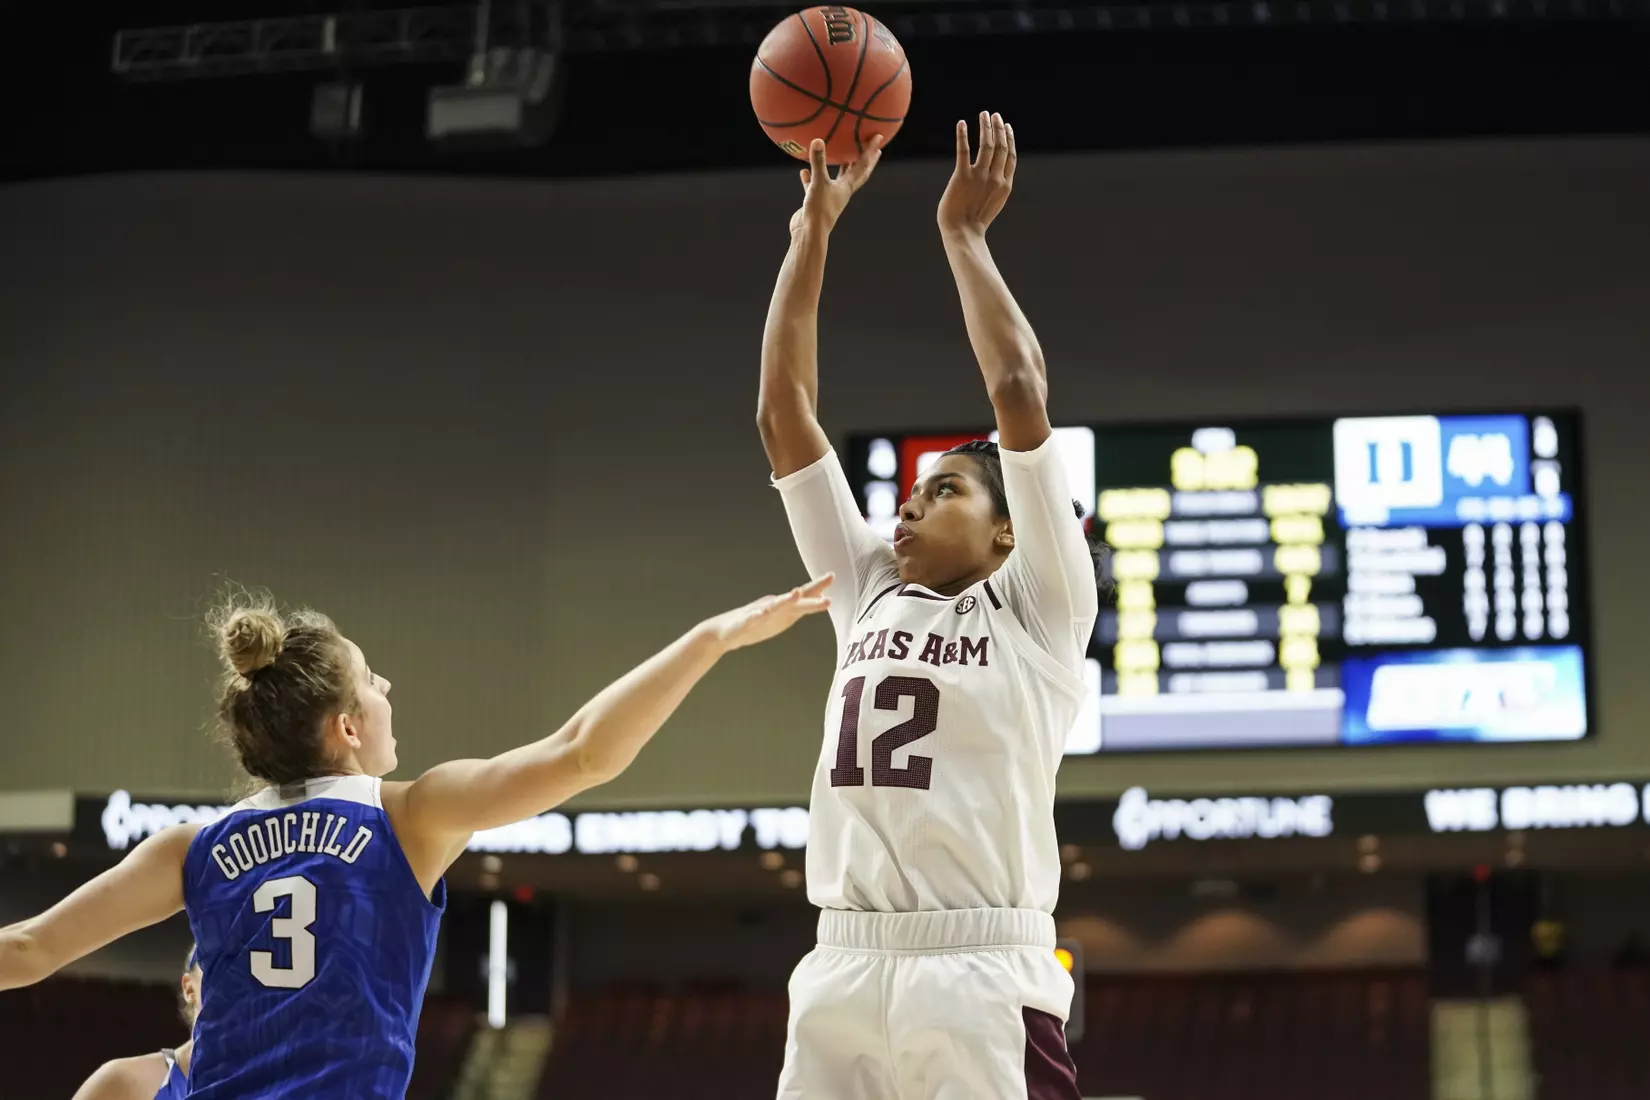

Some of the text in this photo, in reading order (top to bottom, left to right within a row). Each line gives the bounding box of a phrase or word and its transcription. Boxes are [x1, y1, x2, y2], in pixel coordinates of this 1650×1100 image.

[956, 596, 975, 614] SEC
[918, 632, 989, 667] A&M
[830, 675, 941, 791] 12
[211, 811, 374, 881] GOODCHILD
[250, 875, 318, 990] 3
